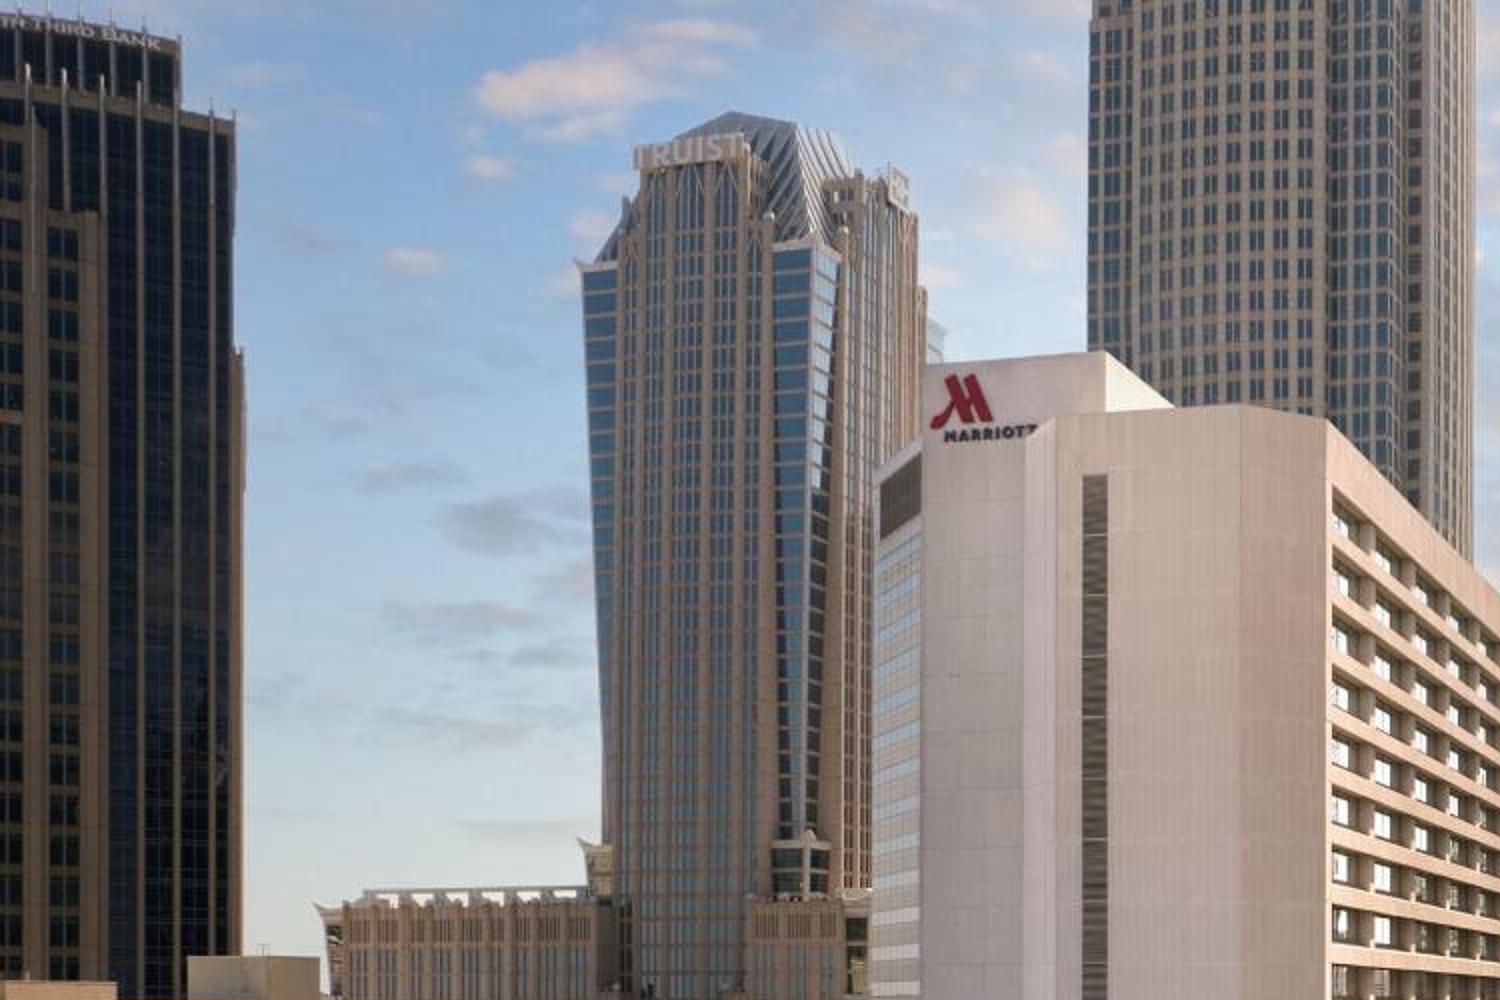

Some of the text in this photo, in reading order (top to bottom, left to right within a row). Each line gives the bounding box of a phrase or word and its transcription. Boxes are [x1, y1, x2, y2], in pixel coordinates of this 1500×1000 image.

[32, 17, 95, 37] THIRD
[102, 26, 161, 49] BANK
[633, 132, 745, 168] TRUIST
